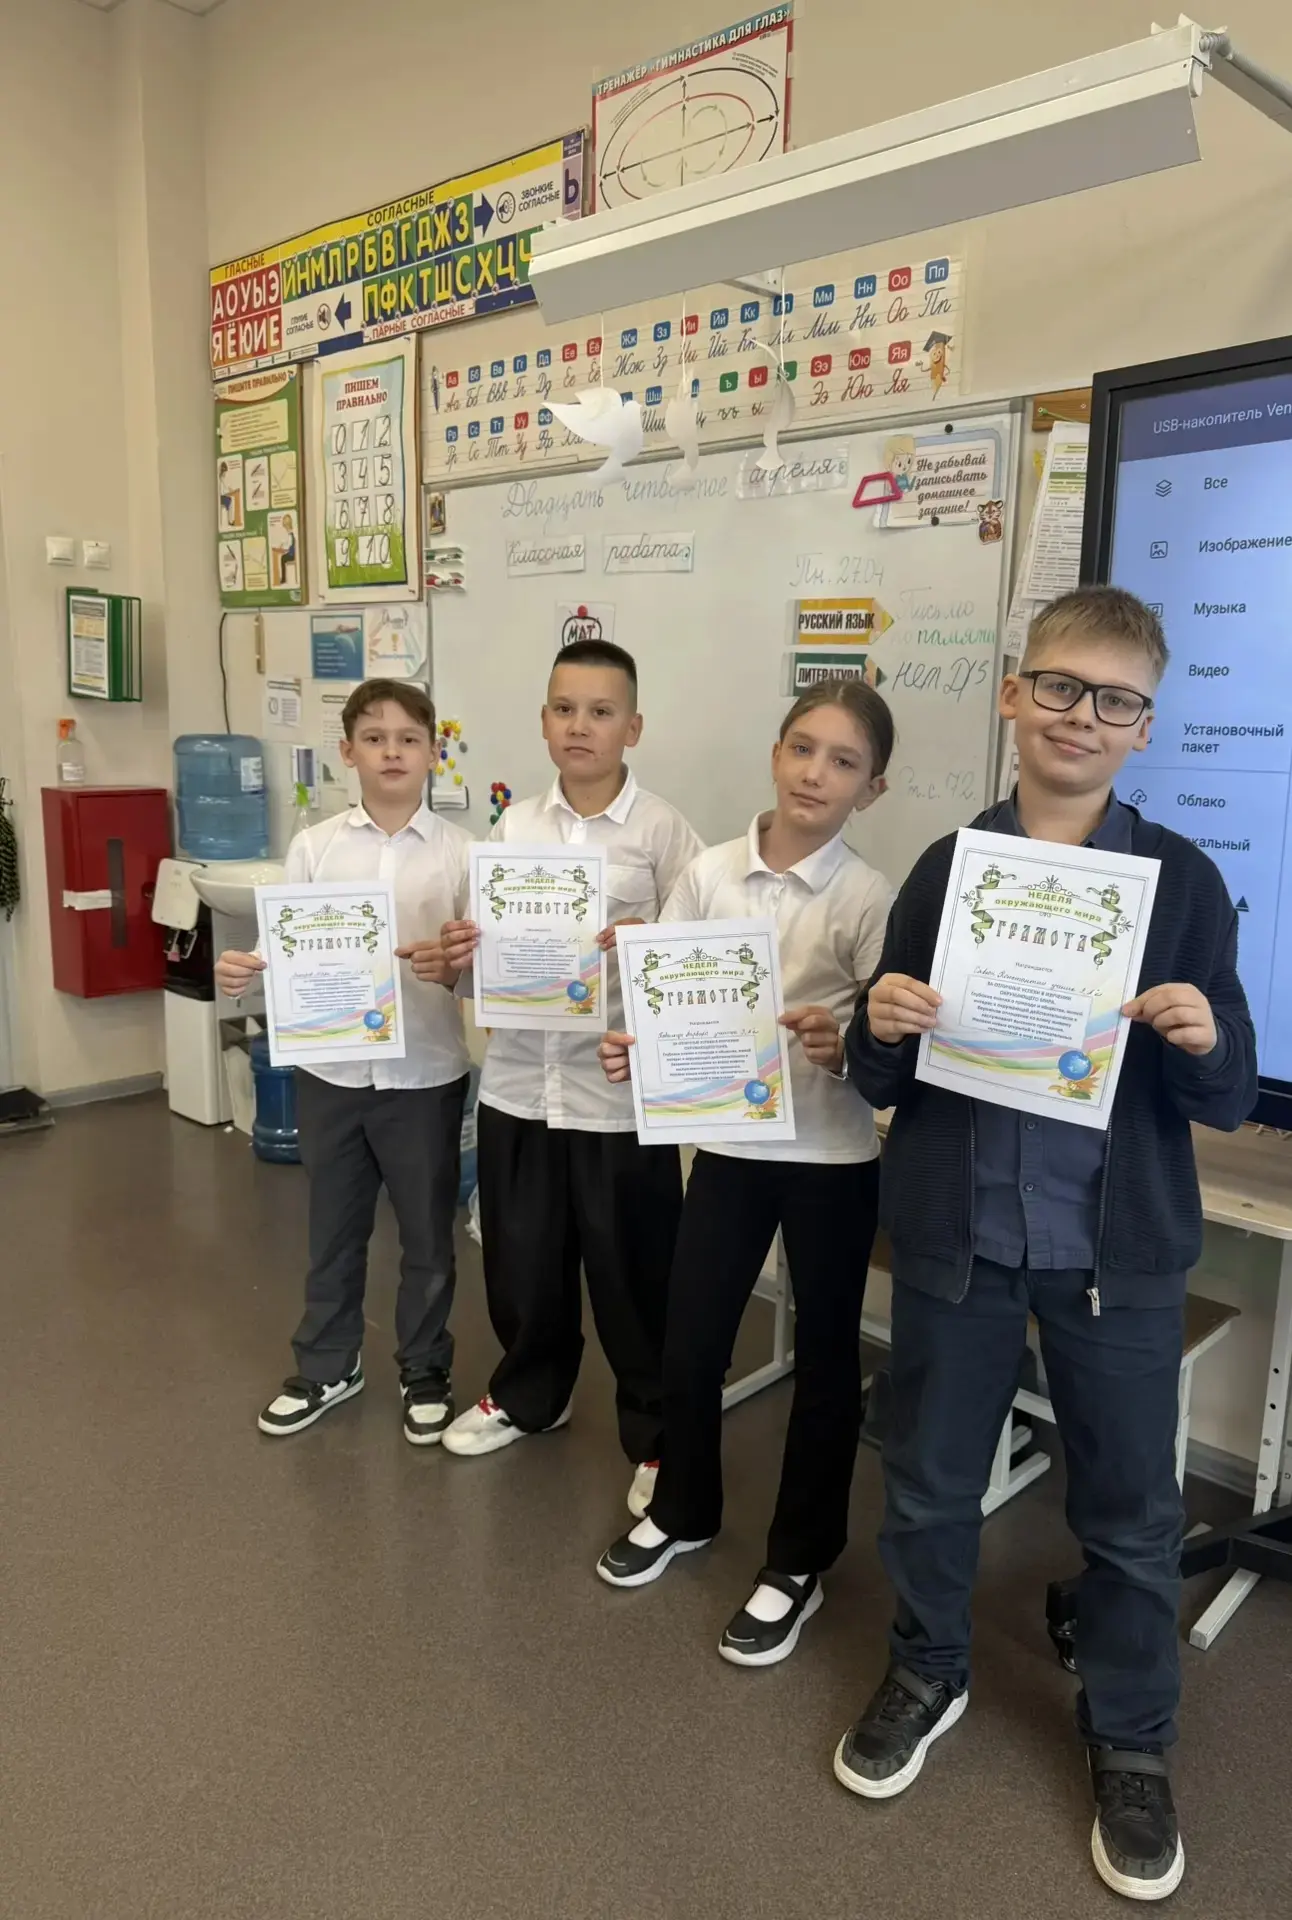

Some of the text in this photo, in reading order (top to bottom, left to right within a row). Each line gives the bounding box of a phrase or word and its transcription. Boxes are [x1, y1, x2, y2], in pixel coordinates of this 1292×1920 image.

[597, 66, 648, 95] ТРЕНАЖЁР
[649, 32, 727, 74] «ГИМНАСТИКА
[728, 22, 752, 44] ДЛЯ
[754, 8, 791, 31] ГЛАЗ»
[521, 180, 554, 200] ЗВОНКИЕ
[367, 190, 435, 227] СОГЛАСНЫЕ
[518, 189, 561, 213] СОГЛАСНЫЕ
[224, 253, 265, 279] ГЛАСНЫЕ
[815, 291, 833, 304] Мм
[857, 281, 874, 295] Нн
[891, 273, 909, 288] Оо
[928, 265, 945, 280] Пп
[849, 302, 877, 331] Нн
[887, 296, 910, 324] Оо
[918, 287, 951, 318] Пп
[372, 303, 466, 340] ПАРНЫЕ СОГЛАСНЫЕ
[344, 377, 380, 394] ПИШЕМ
[810, 380, 829, 406] Ээ
[841, 374, 873, 401] Юю
[884, 368, 910, 395] Яя
[336, 390, 388, 411] ПРАВИЛЬНО
[1153, 408, 1262, 434] USB-накопитель
[359, 419, 370, 450] 1
[378, 414, 391, 447] 2
[337, 454, 392, 493] 3 4 5
[916, 453, 987, 473] Не забывай
[915, 469, 988, 491] записывать
[1204, 477, 1228, 490] Все
[917, 487, 976, 505] домашнее
[339, 493, 395, 530] 6 7 8
[503, 480, 604, 535] Двадцать
[917, 499, 971, 520] задание!
[340, 532, 391, 567] 9 10
[508, 540, 585, 564] Классная
[798, 611, 875, 630] РУССКИЙ ЯЗЫК
[1193, 601, 1247, 619] Музыка
[567, 624, 596, 643] МАТ
[1188, 664, 1230, 679] Видео
[1183, 723, 1285, 738] Установочный
[1181, 741, 1220, 754] пакет
[1177, 793, 1226, 809] Облако
[1185, 837, 1251, 852] кальный
[509, 901, 570, 915] ГРАМОТА
[1028, 890, 1073, 905] НЕДЕЛЯ
[994, 898, 1103, 924] окружающего мира
[300, 936, 361, 951] ГРАМОТА
[996, 919, 1088, 953] ГРАМОТА
[660, 970, 720, 981] окружающего
[683, 961, 719, 969] НЕДЕЛЯ
[668, 988, 740, 1006] ГРАМОТА
